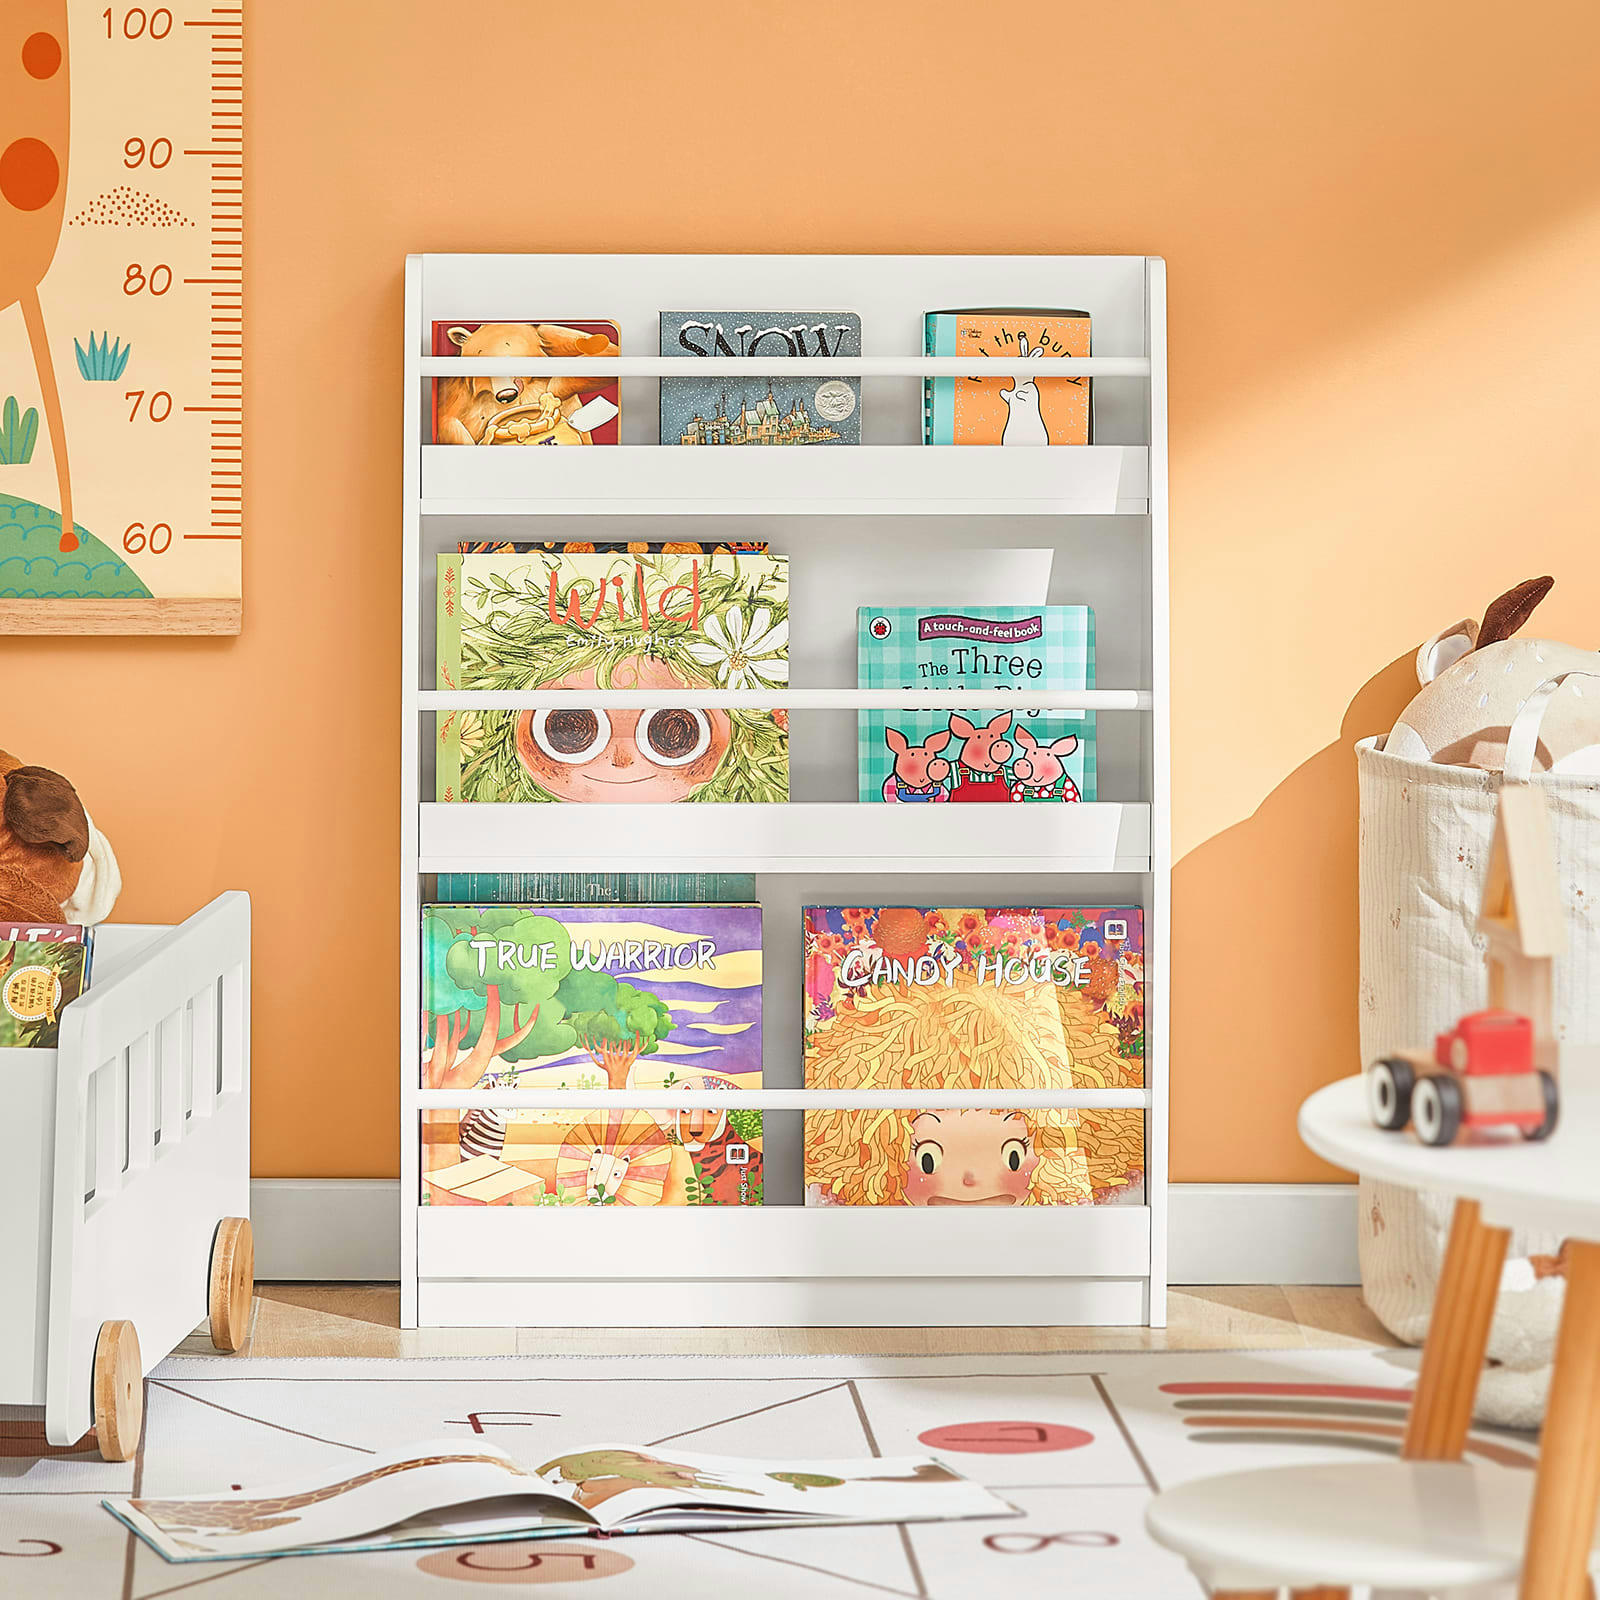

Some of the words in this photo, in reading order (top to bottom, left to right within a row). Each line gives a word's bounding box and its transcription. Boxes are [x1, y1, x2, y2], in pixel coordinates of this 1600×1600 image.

[102, 7, 173, 39] 100
[123, 137, 173, 169] 90
[123, 263, 173, 296] 80
[678, 320, 852, 358] SNOW
[994, 328, 1027, 347] the
[124, 391, 173, 423] 70
[122, 523, 173, 555] 60
[566, 633, 615, 652] Emily
[624, 631, 686, 652] Hughes
[924, 622, 932, 633] A
[933, 622, 1014, 638] touch-and-feel
[1015, 624, 1040, 638] book
[918, 663, 949, 678] The
[951, 646, 1043, 679] Three
[588, 883, 613, 896] The
[469, 939, 557, 977] TRUE
[569, 939, 718, 972] WARRIOR
[841, 949, 963, 988] CANDY
[977, 951, 1093, 988] HOUSE
[740, 1182, 749, 1203] Show
